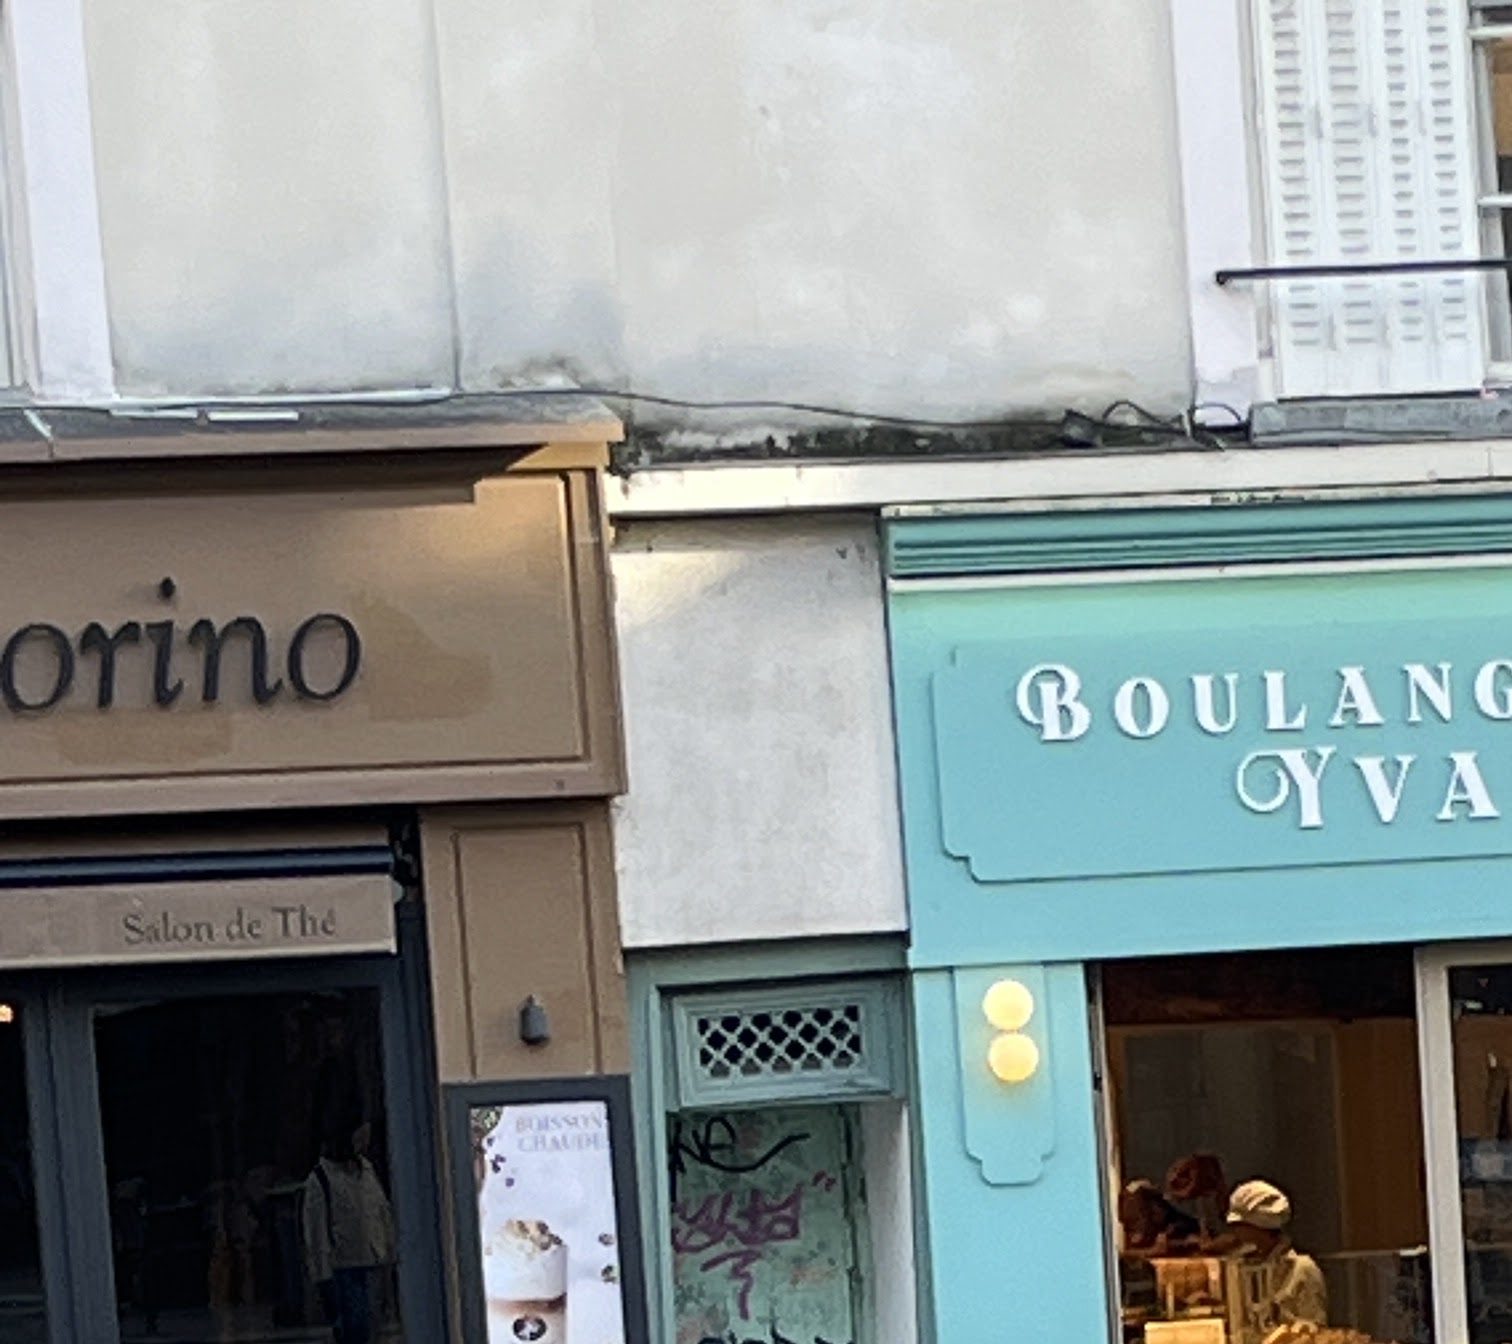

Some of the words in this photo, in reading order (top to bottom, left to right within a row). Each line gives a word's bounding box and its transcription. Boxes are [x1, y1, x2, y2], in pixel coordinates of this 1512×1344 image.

[0, 576, 362, 711] orino
[122, 911, 214, 945] Salon
[226, 907, 262, 940] de
[271, 904, 336, 938] Thé
